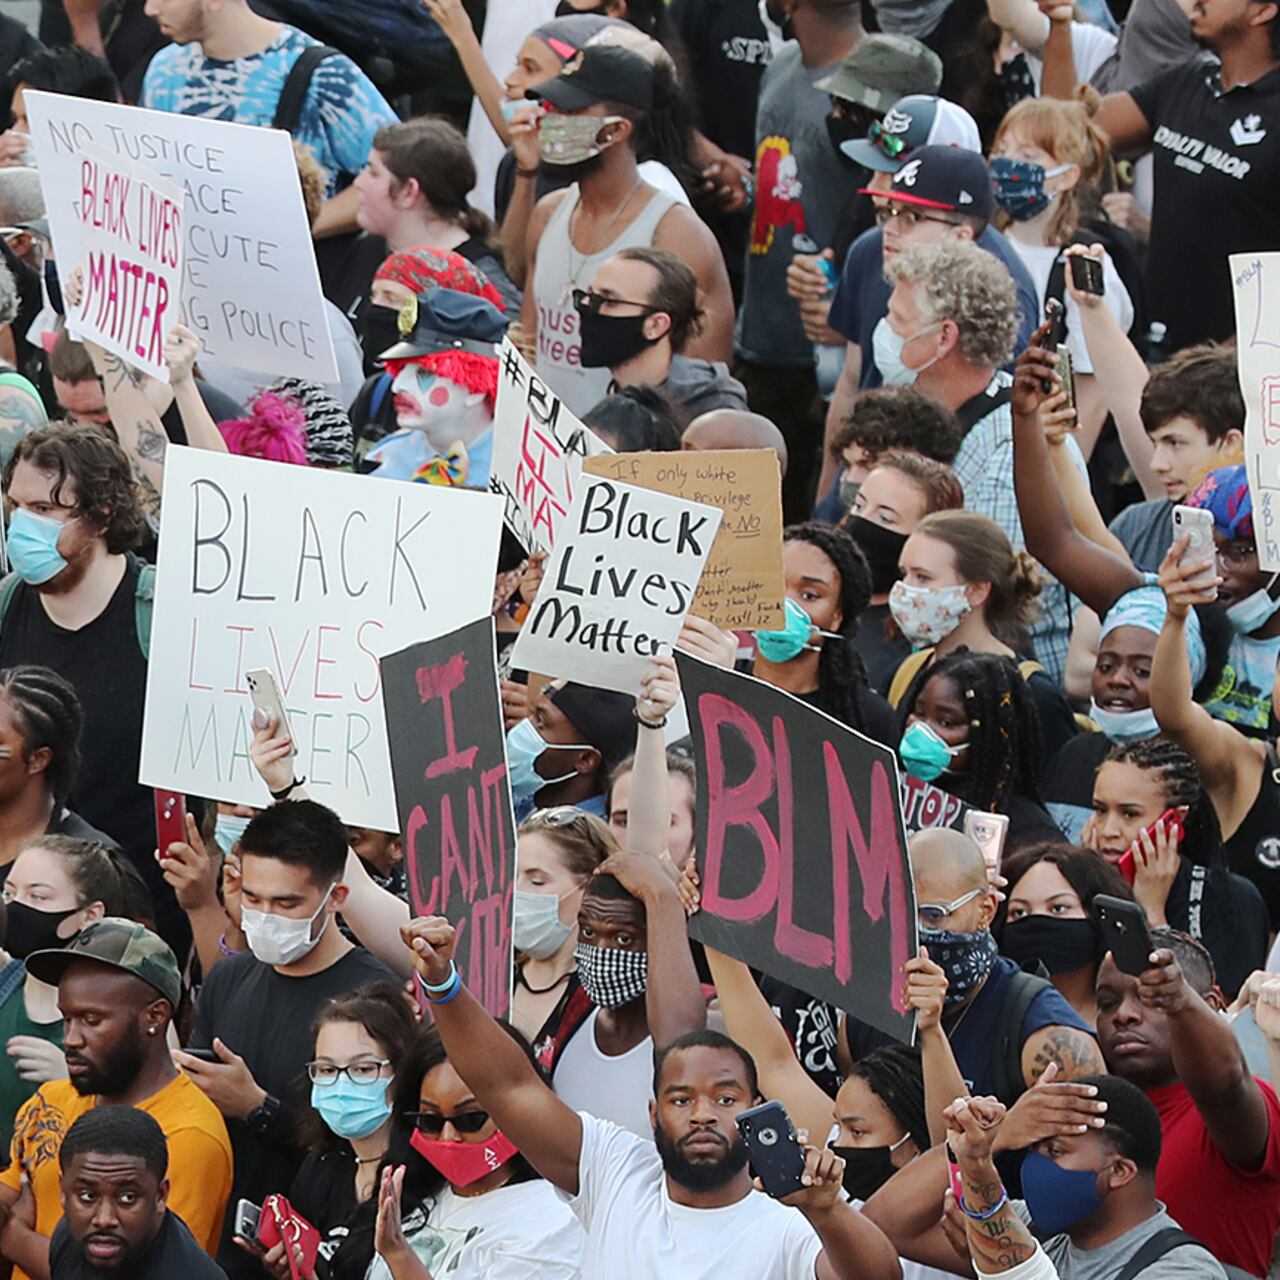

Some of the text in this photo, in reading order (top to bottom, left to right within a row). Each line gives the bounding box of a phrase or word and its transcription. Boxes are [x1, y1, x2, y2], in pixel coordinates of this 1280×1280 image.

[104, 123, 225, 174] JUSTICE
[80, 159, 181, 270] BLACK LIVES
[182, 177, 245, 215] ACE
[80, 250, 169, 368] MATTER
[220, 300, 315, 360] POLICE
[656, 463, 688, 488] only
[695, 465, 737, 484] white
[189, 478, 432, 612] BLACK
[579, 481, 708, 557] Black
[740, 514, 762, 532] NO
[555, 545, 691, 616] Lives
[188, 616, 384, 704] LIVES
[530, 597, 670, 658] Matter
[415, 650, 470, 780] I
[902, 777, 960, 830] TOP
[697, 692, 911, 1018] BLM
